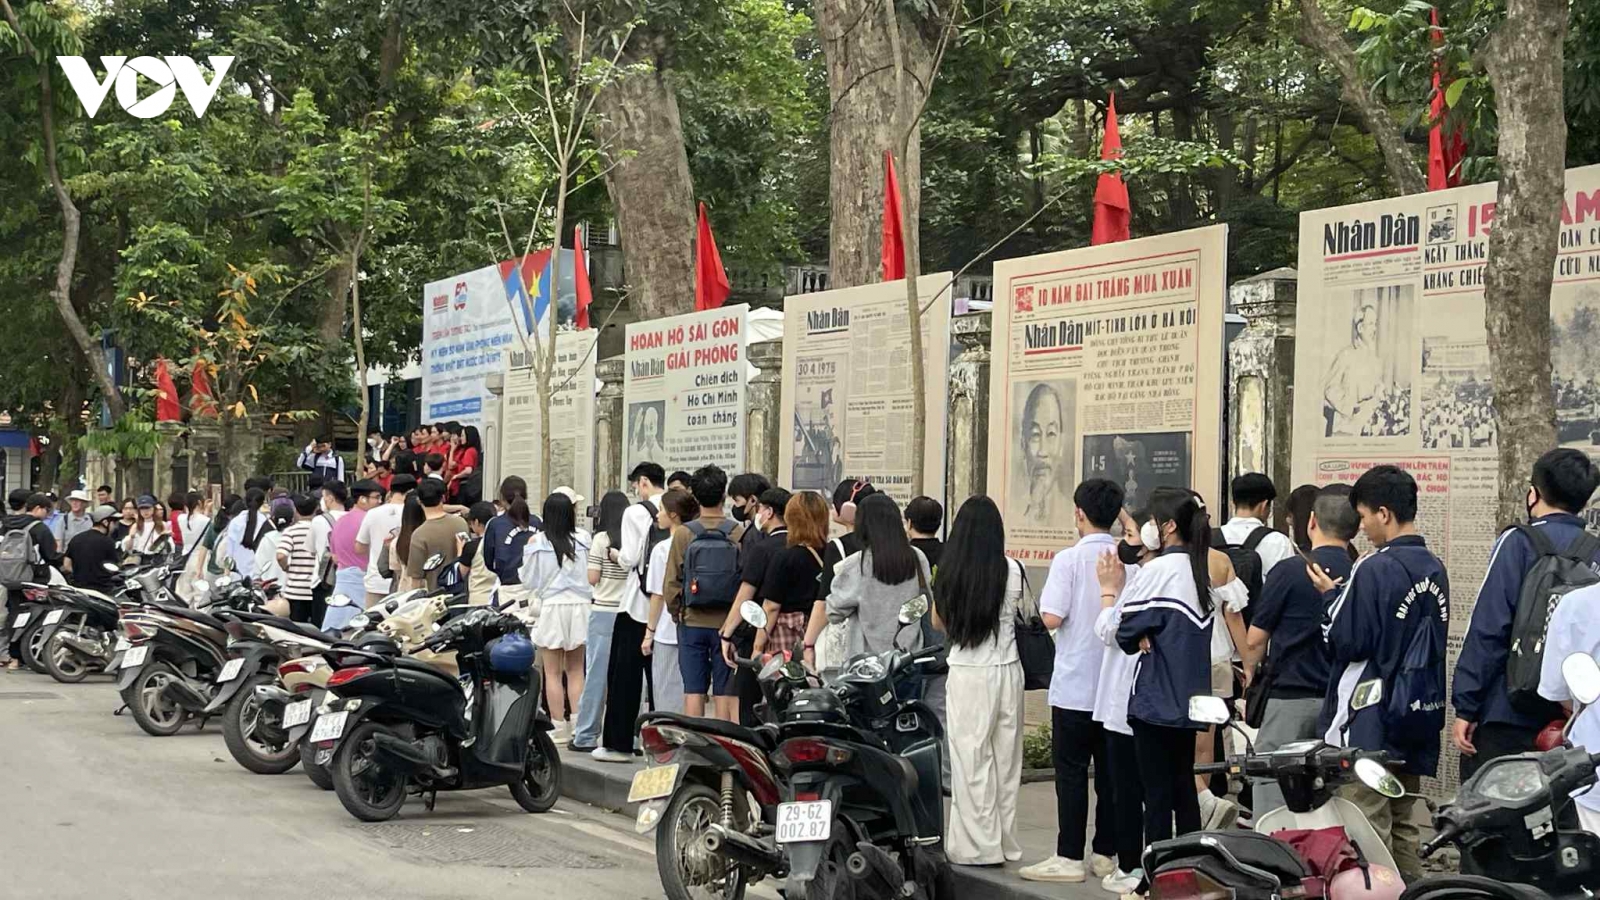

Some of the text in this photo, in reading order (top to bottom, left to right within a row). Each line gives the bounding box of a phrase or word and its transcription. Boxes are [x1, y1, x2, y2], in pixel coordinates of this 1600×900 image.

[1324, 212, 1420, 256] Nhân Dân
[1560, 229, 1581, 248] OÀN
[1460, 266, 1484, 286] CHIẾ
[1038, 288, 1048, 307] 10
[1162, 267, 1192, 290] XUÂN
[807, 309, 830, 330] Nhân
[832, 307, 849, 327] Dân
[631, 331, 663, 351] HOAN
[1025, 320, 1083, 349] Nhân Dân
[667, 342, 738, 370] GIẢI PHÓNG
[632, 359, 650, 377] Nhân
[721, 370, 738, 384] dịch
[687, 394, 699, 407] Hồ
[717, 390, 738, 404] Minh
[1033, 548, 1056, 560] THẮN
[780, 820, 827, 839] 002.87
